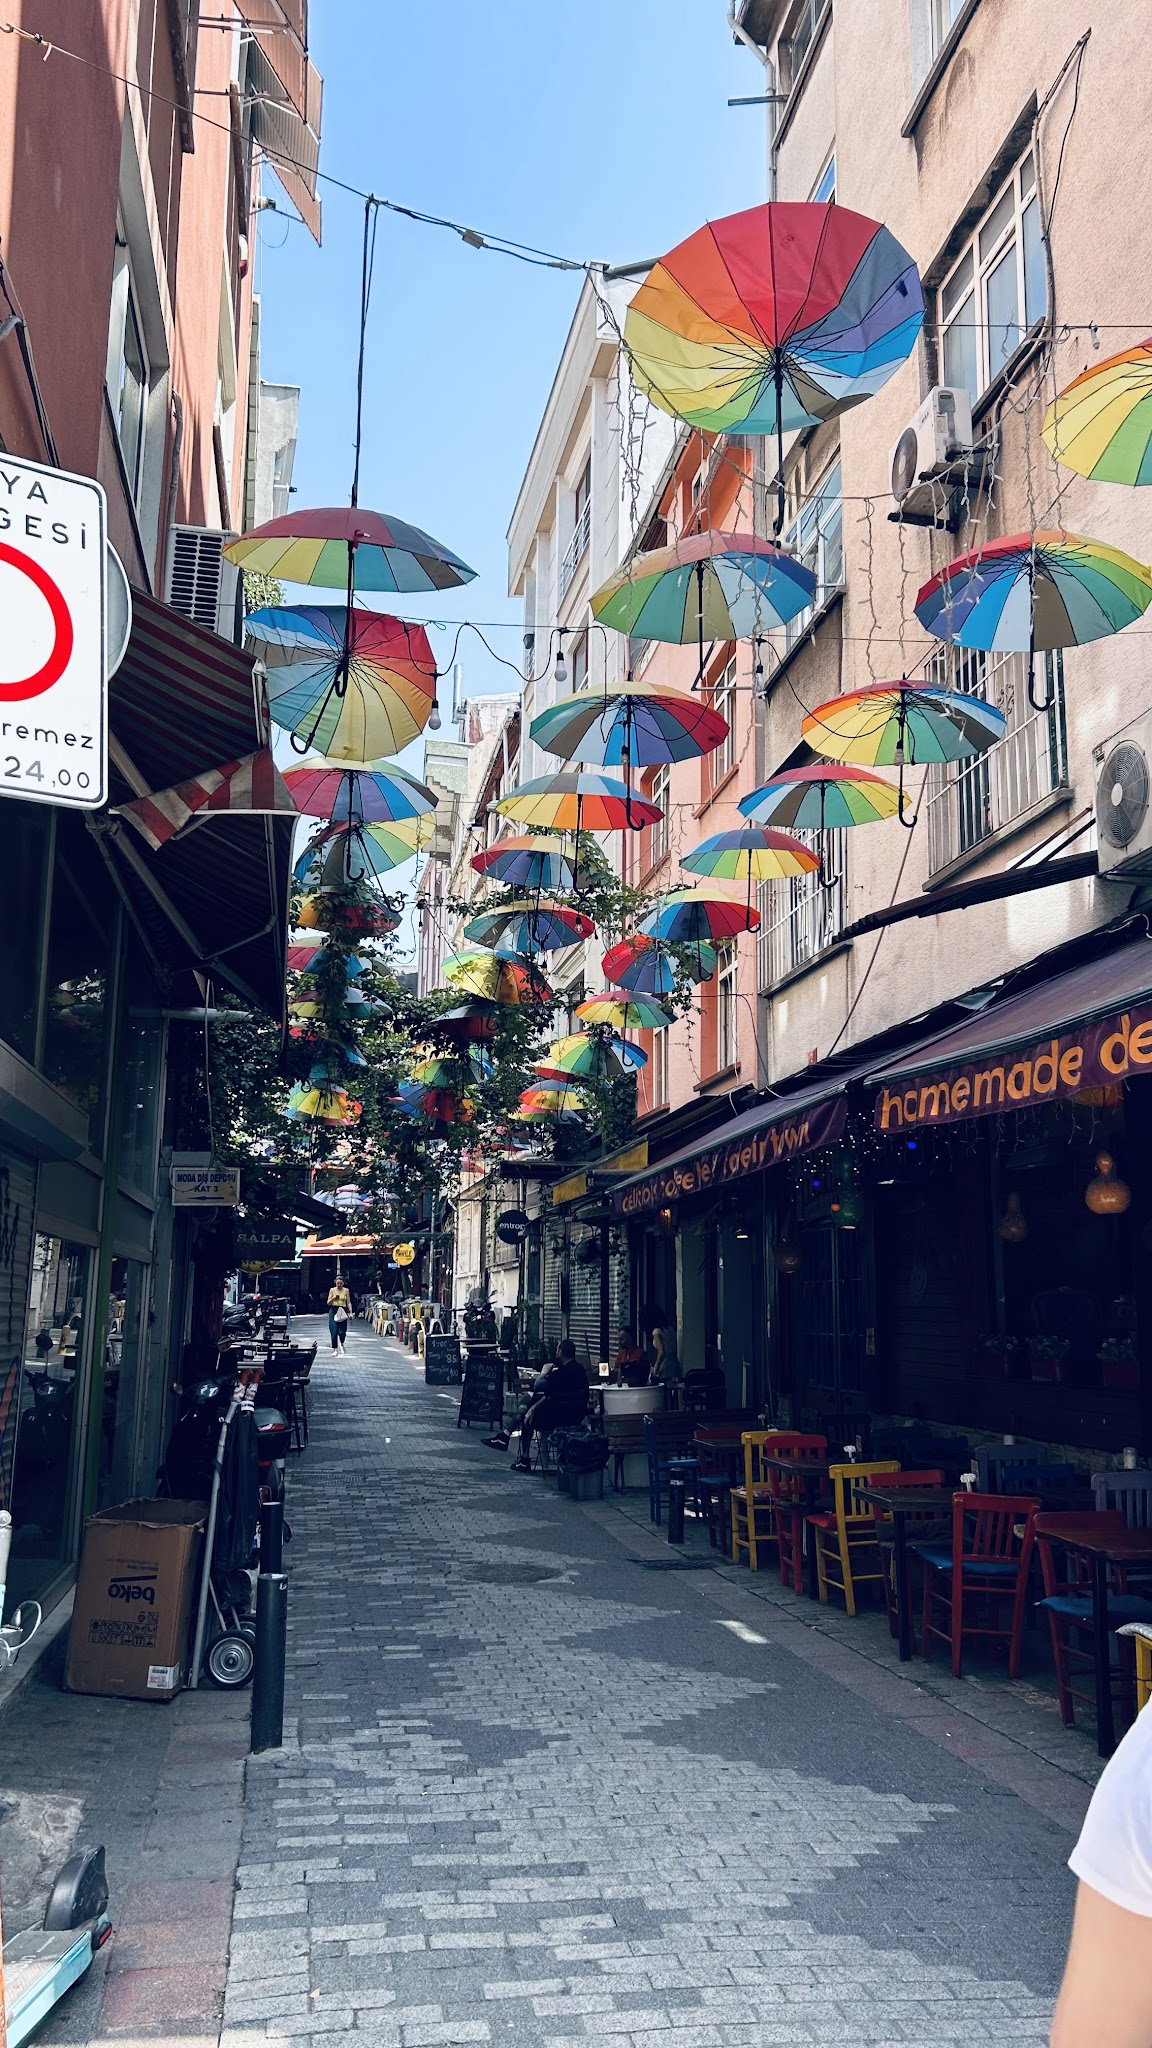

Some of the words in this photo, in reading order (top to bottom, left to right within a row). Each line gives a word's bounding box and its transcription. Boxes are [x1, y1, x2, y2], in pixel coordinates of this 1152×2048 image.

[2, 722, 94, 749] remez
[880, 1039, 1084, 1129] homemade
[177, 1173, 196, 1183] MODA
[210, 1173, 236, 1183] DEPOSU
[194, 1185, 211, 1193] KAT
[213, 1185, 219, 1193] 3
[237, 1233, 294, 1244] SALPA
[107, 1583, 156, 1605] beko
